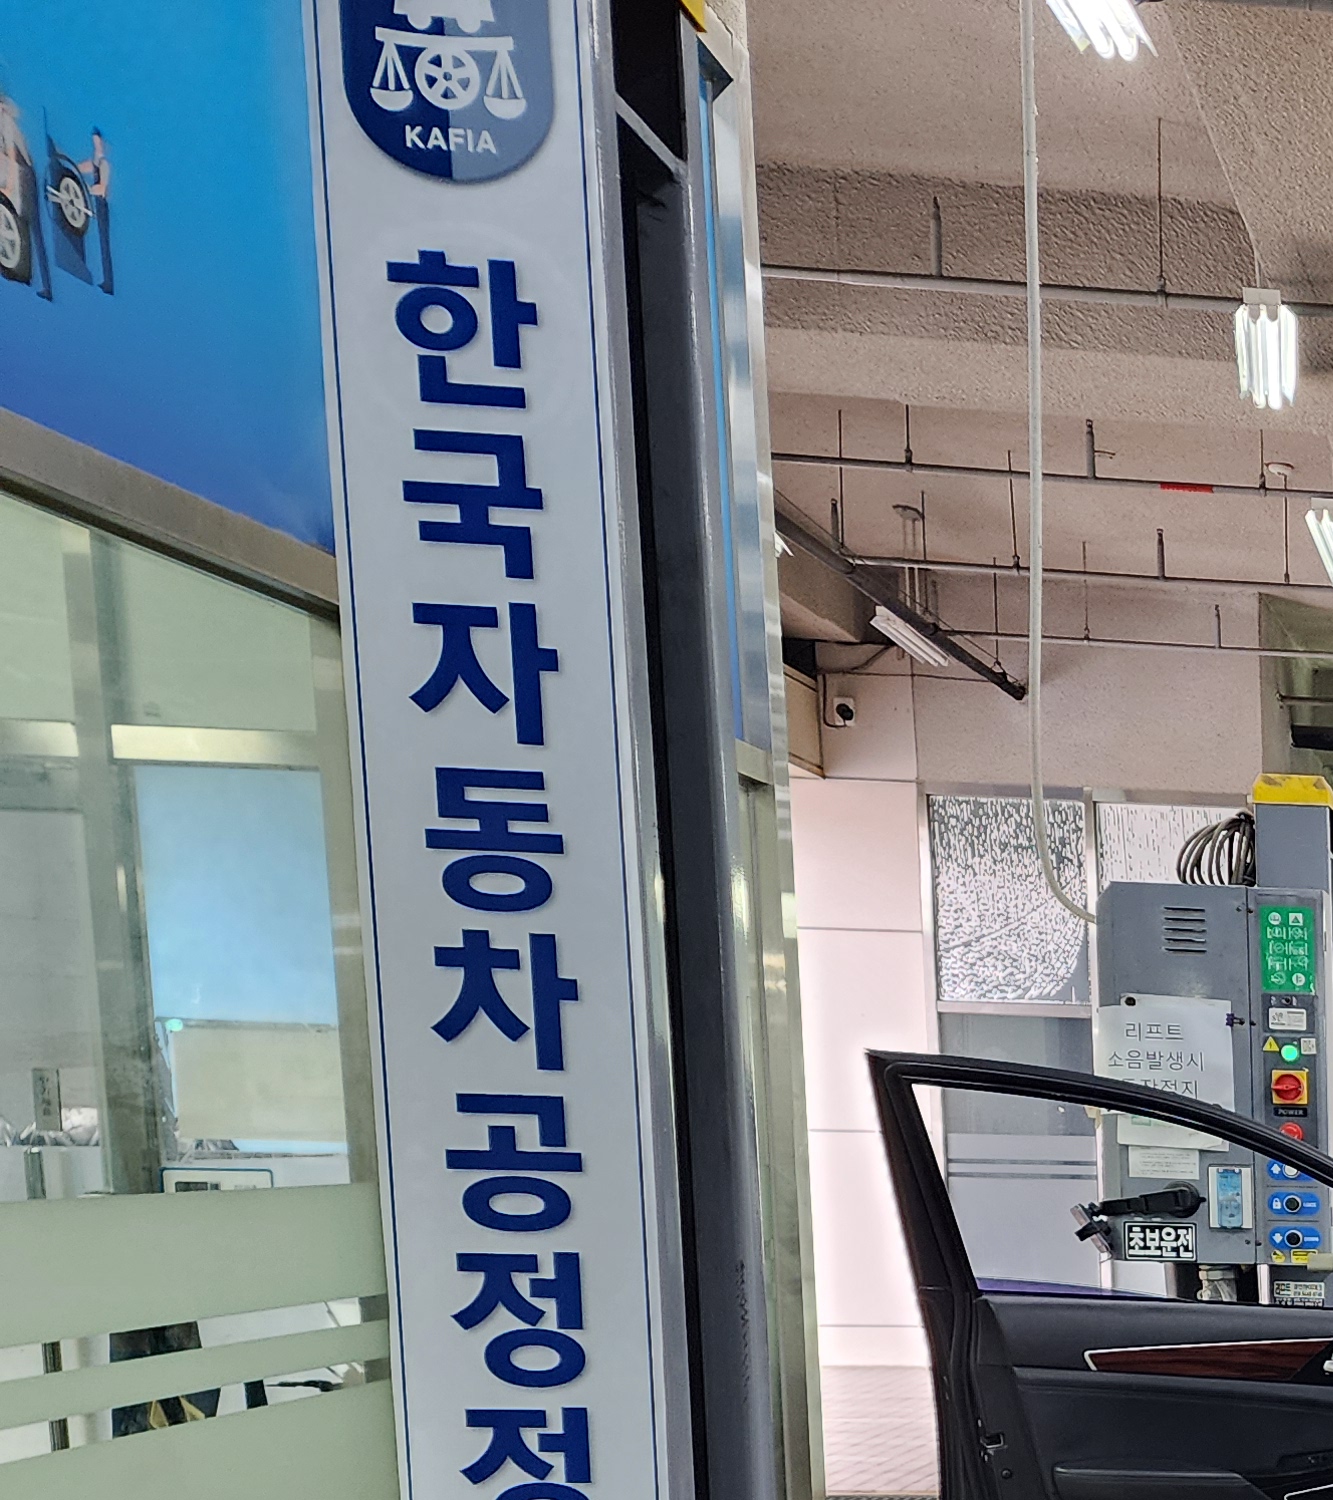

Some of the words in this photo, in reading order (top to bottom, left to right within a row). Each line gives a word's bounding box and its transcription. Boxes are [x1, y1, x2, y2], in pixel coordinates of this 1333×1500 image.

[405, 124, 498, 154] KAFIA
[1125, 1022, 1184, 1042] 리프트
[1107, 1049, 1204, 1072] 소음발생시
[1128, 1226, 1193, 1258] 초보운전
